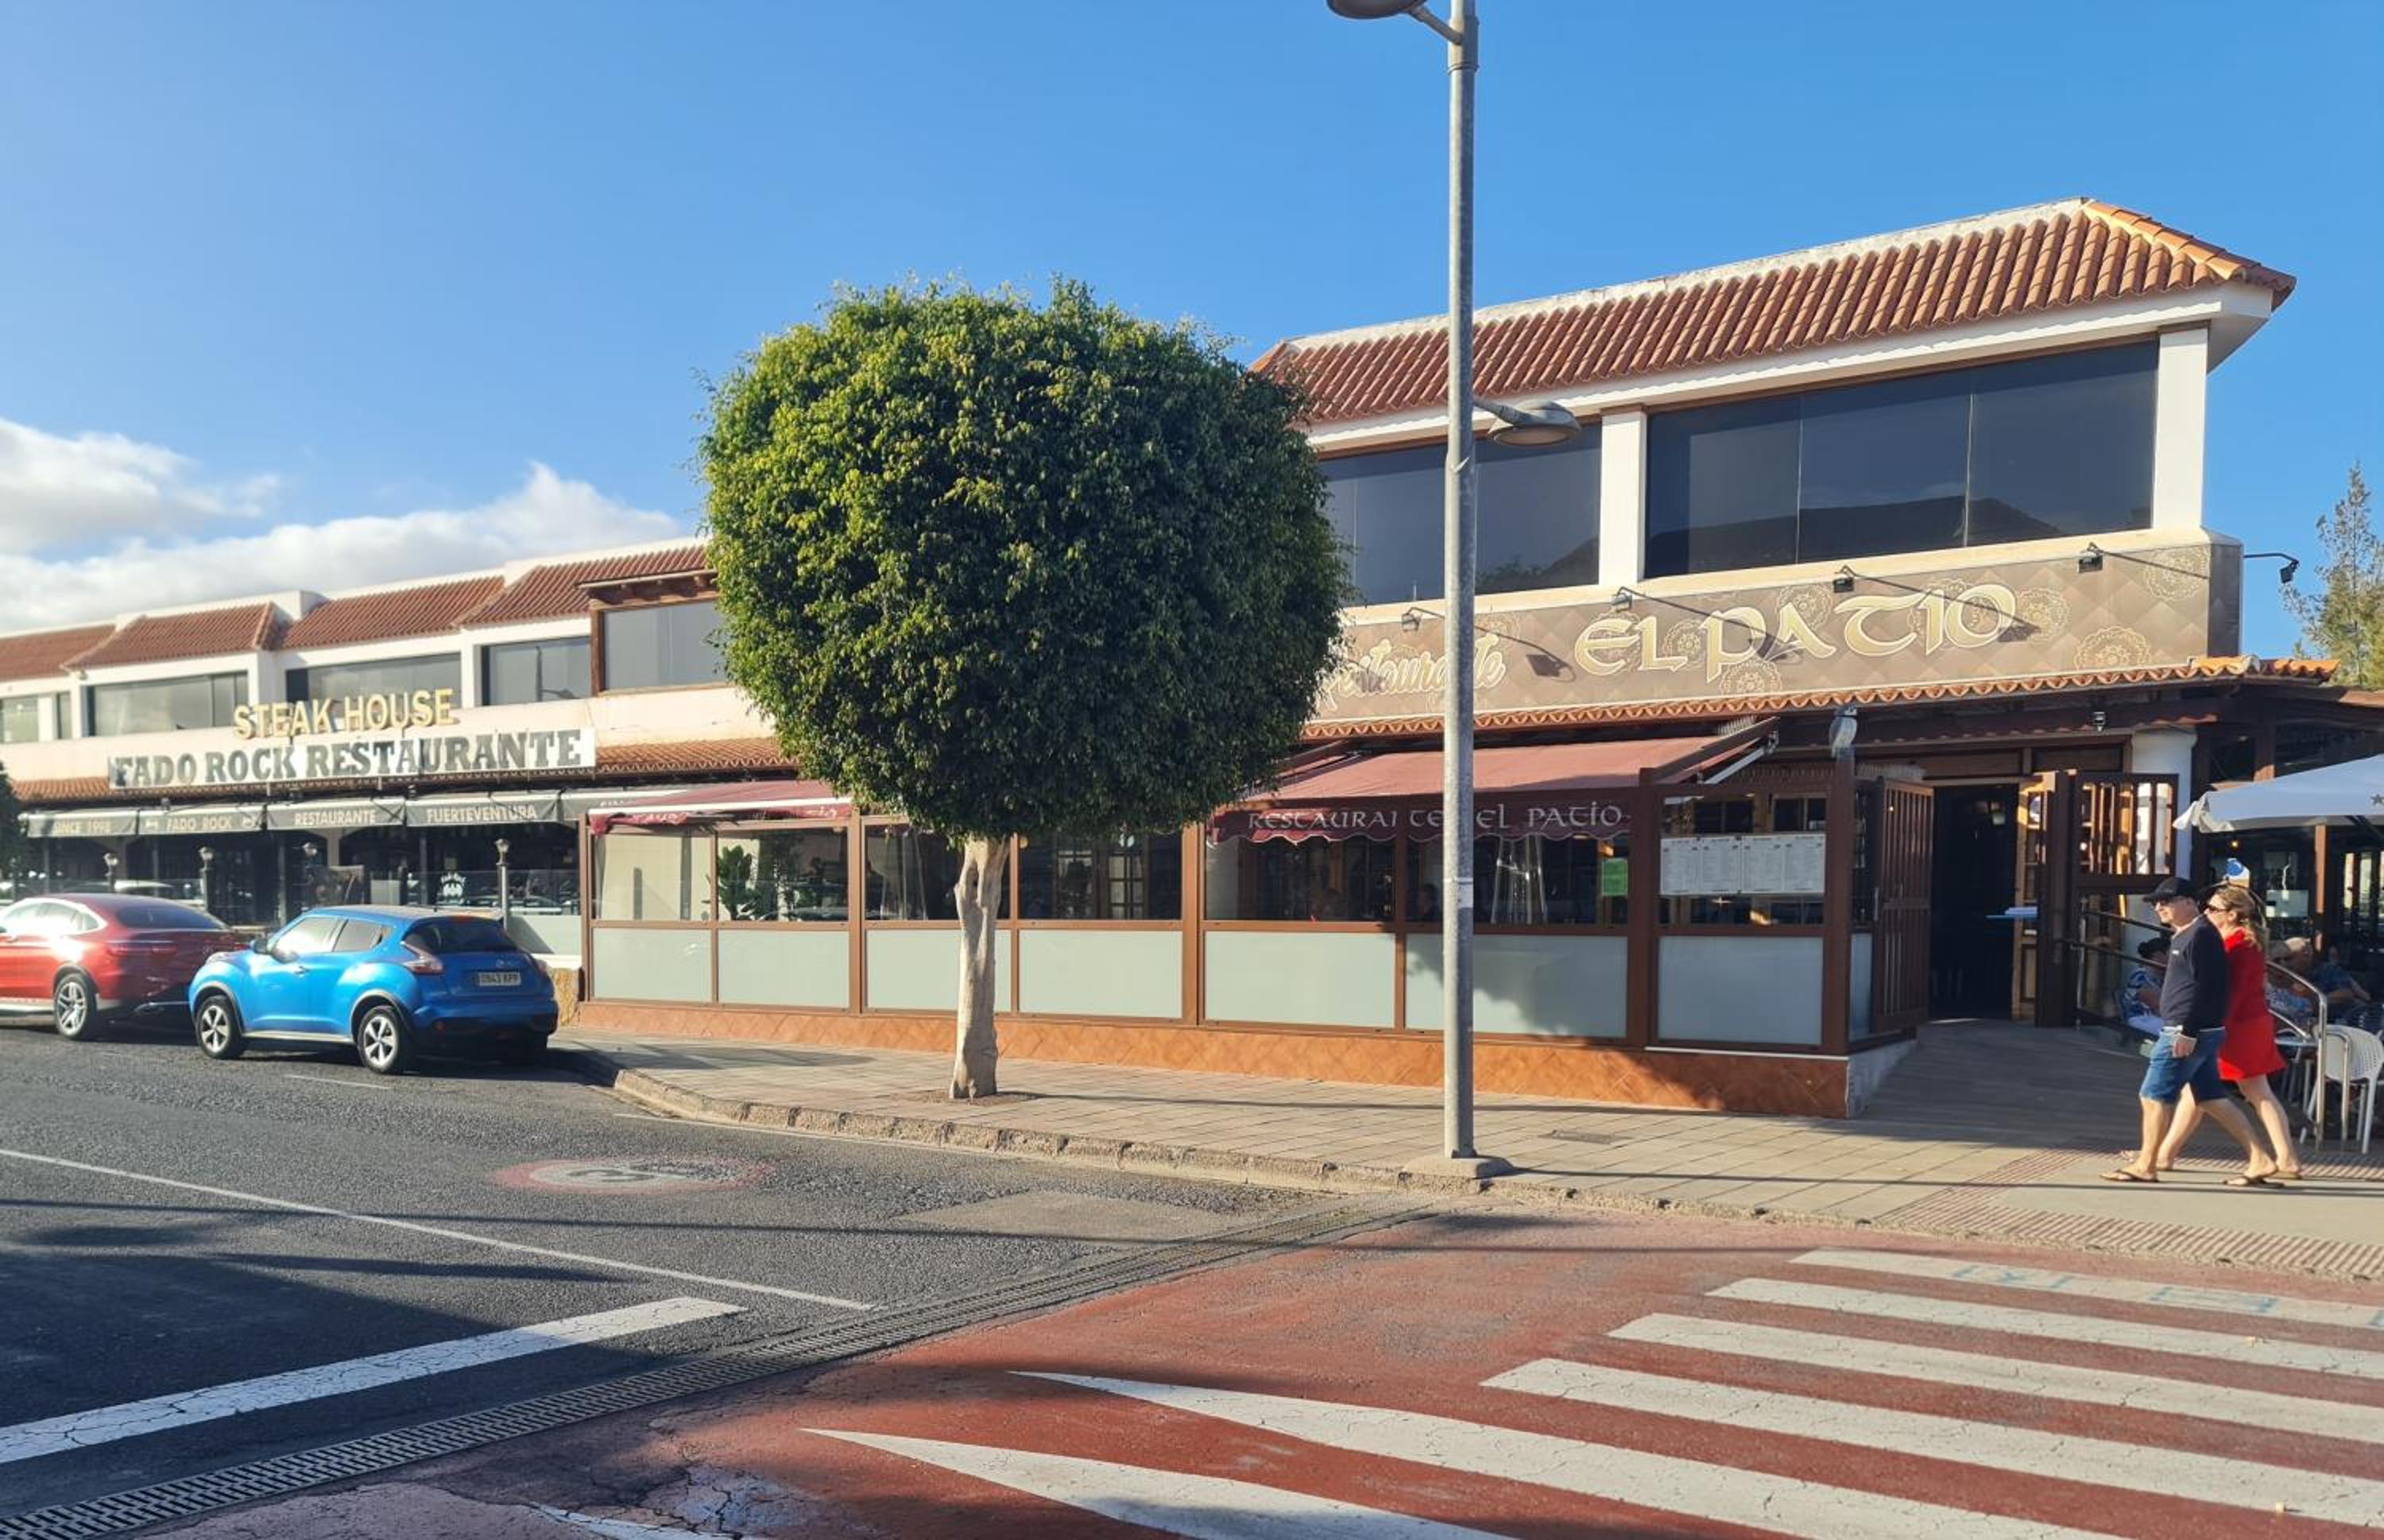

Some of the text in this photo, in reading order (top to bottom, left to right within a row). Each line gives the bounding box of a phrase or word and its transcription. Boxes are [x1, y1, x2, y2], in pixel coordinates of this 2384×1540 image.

[1574, 614, 1689, 676] EL
[1700, 583, 2017, 684] PATIO
[234, 688, 454, 740] STEAK HOUSE
[115, 729, 581, 787] FADO ROCK RESTAURANTE
[203, 815, 232, 830] ROCK
[295, 809, 376, 826] RESTAURANTE
[428, 804, 537, 823] FUERTEVENTURA
[1248, 808, 1445, 830] RESTAURATE
